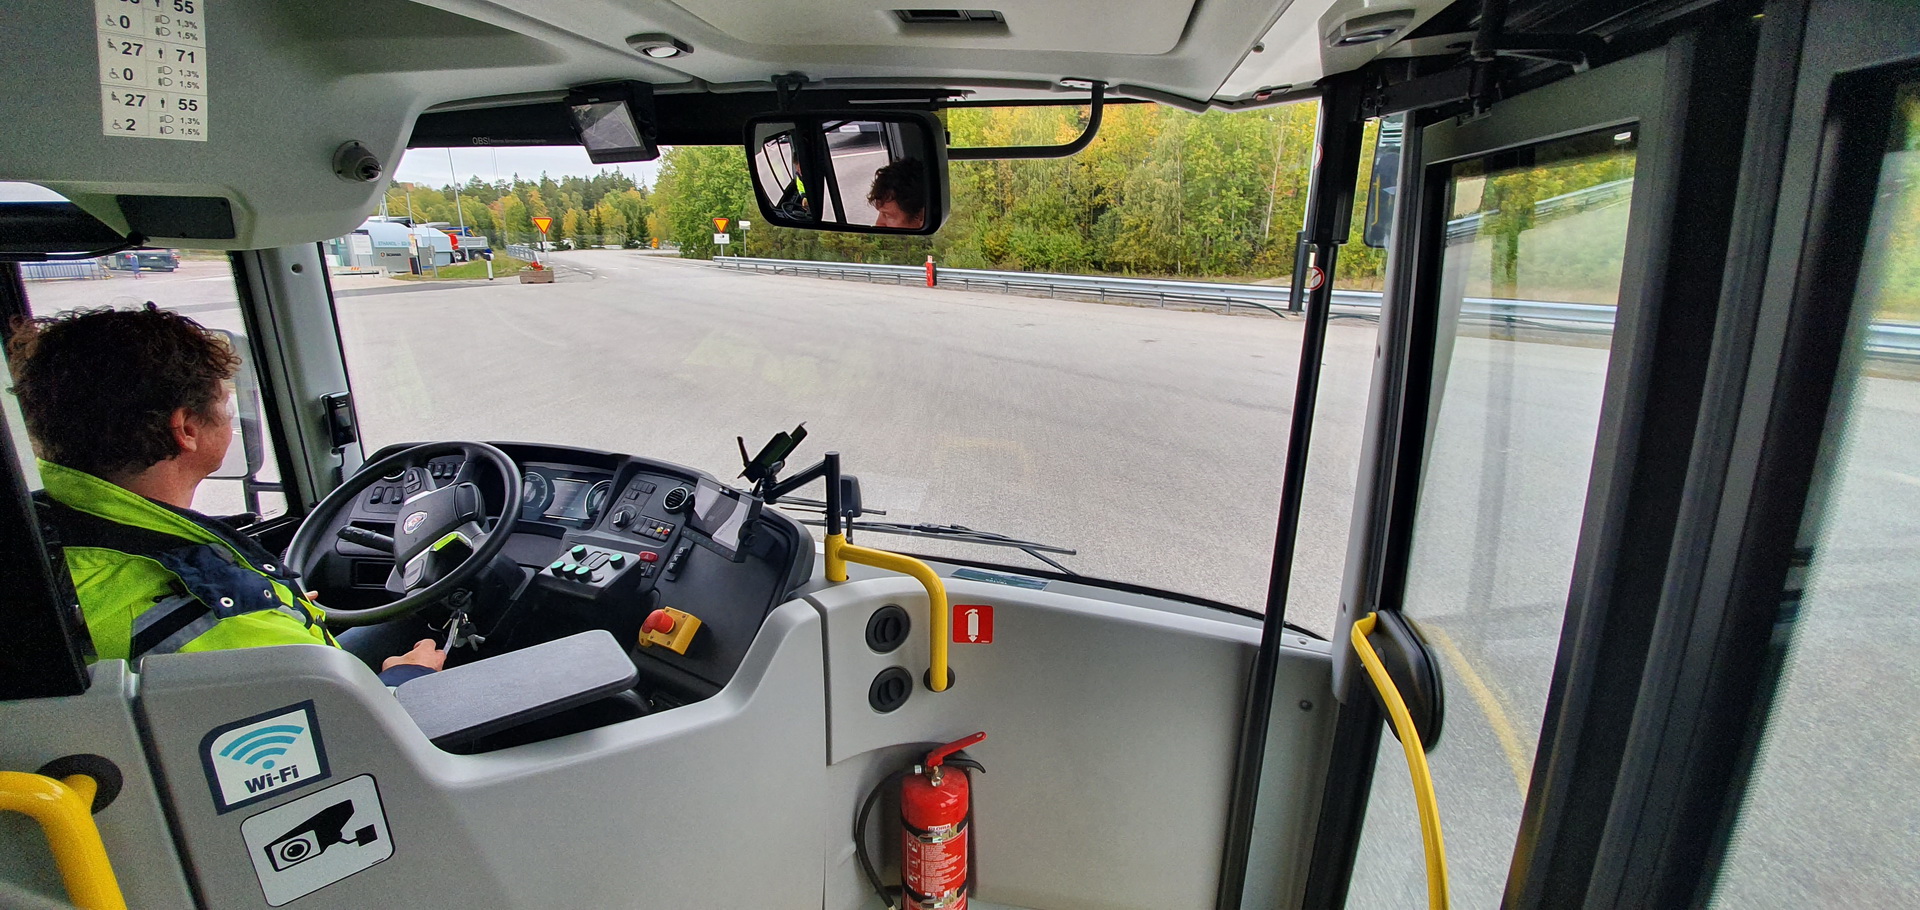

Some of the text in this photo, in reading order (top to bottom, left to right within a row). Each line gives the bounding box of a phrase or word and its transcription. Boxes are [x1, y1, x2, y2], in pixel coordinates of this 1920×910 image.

[174, 0, 195, 14] 55
[119, 15, 131, 29] 0
[177, 19, 198, 30] 1,3%
[177, 31, 198, 41] 1,5%
[121, 41, 143, 57] 27
[176, 49, 195, 64] 71
[123, 67, 134, 81] 0
[179, 69, 200, 79] 1,3%
[179, 80, 200, 90] 1,5%
[124, 93, 146, 107] 27
[178, 98, 198, 112] 55
[125, 118, 136, 131] 2
[180, 117, 200, 126] 1,3%
[180, 128, 200, 136] 1,5%
[244, 764, 300, 794] Wi-Fi
